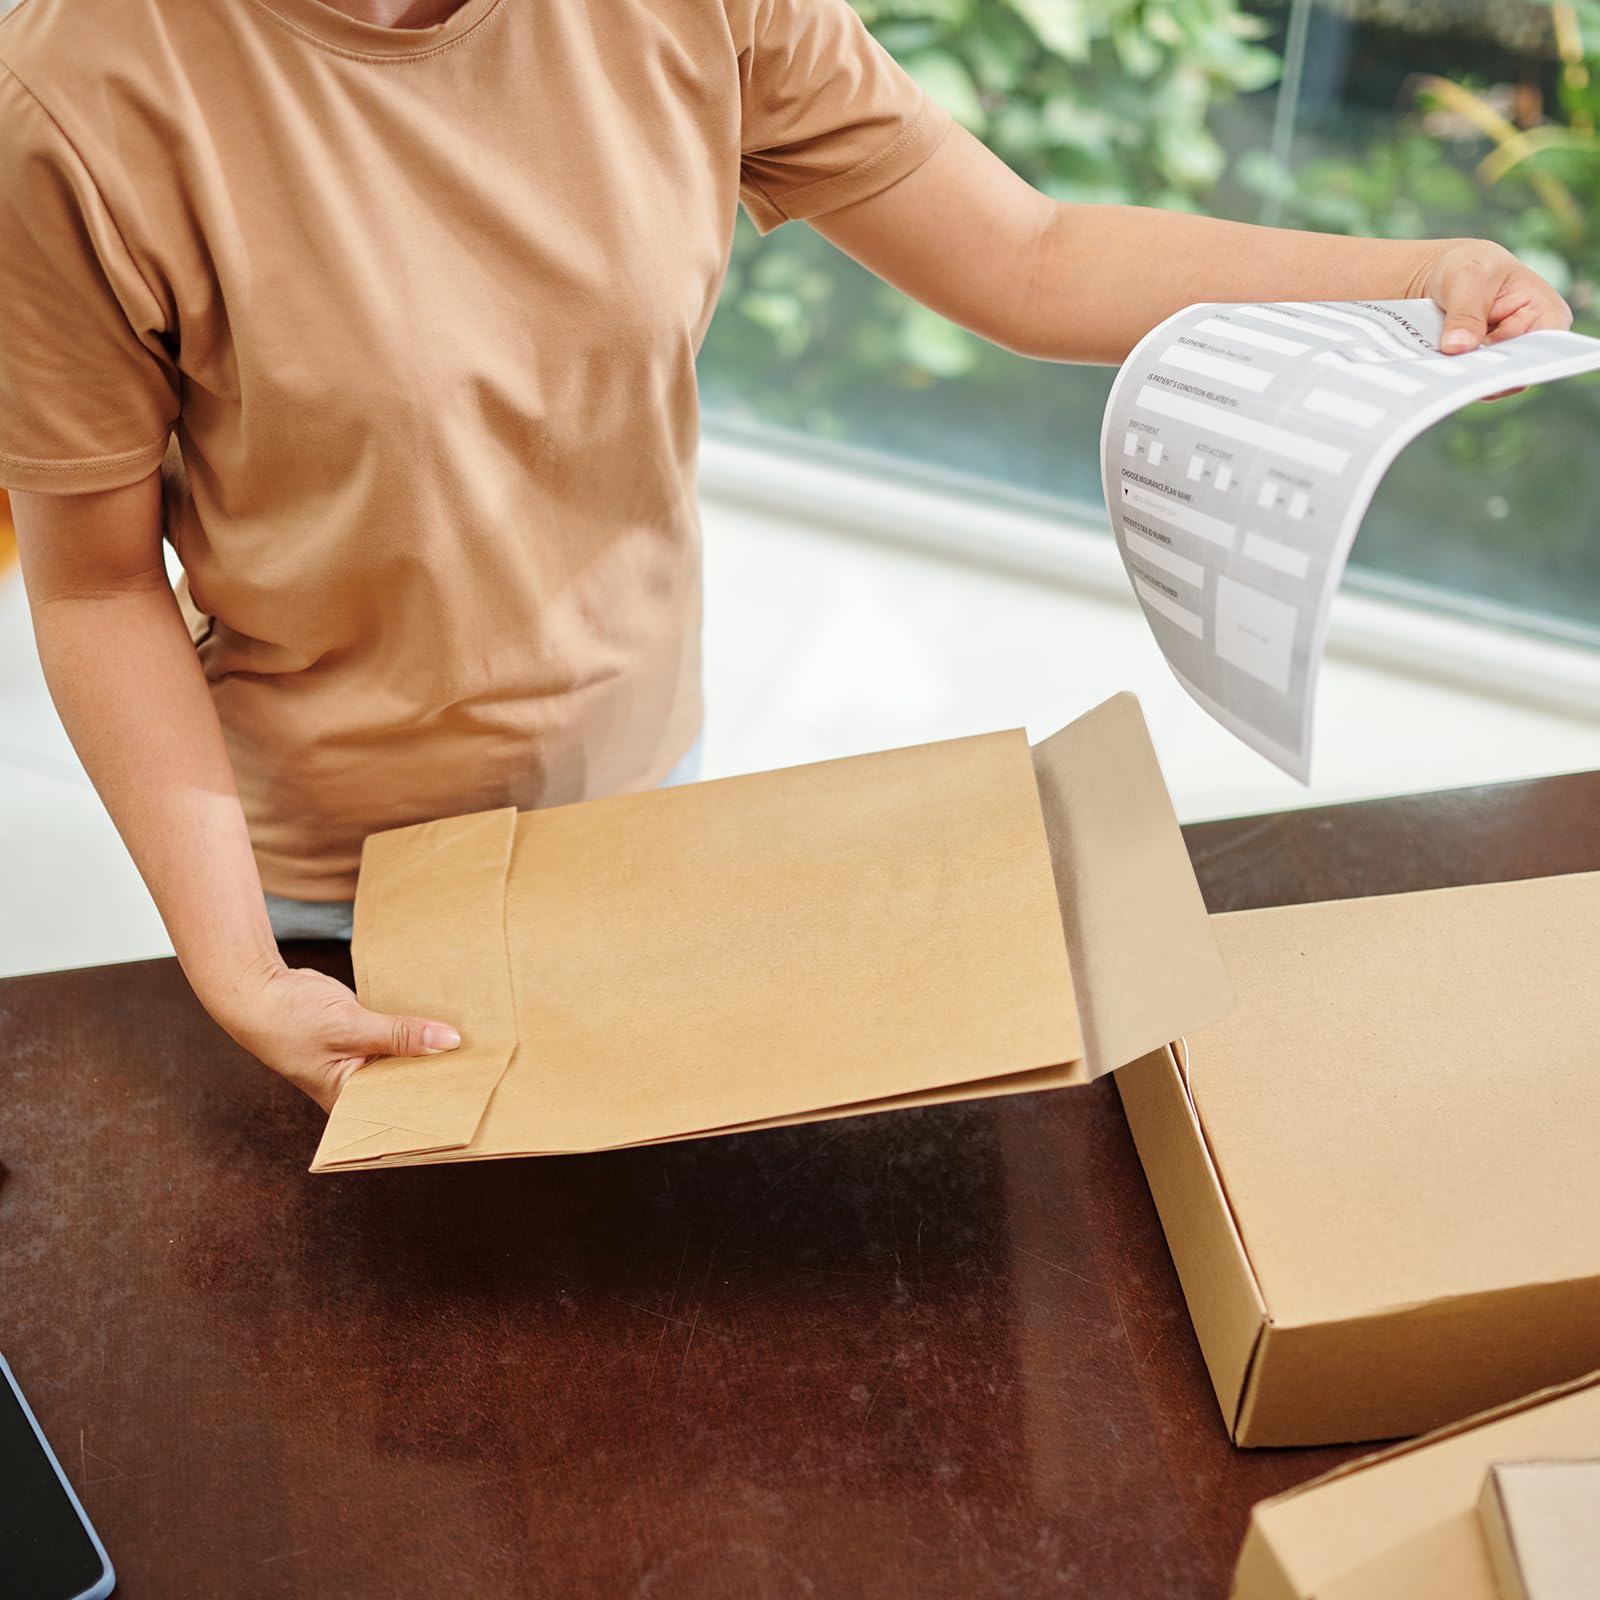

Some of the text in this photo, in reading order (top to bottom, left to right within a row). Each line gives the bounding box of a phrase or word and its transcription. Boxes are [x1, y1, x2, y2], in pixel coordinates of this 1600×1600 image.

[1178, 336, 1208, 350] TELEPHONE
[1147, 373, 1154, 381] IS
[1153, 374, 1177, 388] PATIENT'S
[1177, 383, 1206, 397] CONDITION
[1205, 391, 1229, 405] RELATED
[1128, 419, 1159, 436] EMPLOYMENT
[1121, 468, 1139, 481] CHOOSE
[1139, 474, 1164, 491] INSURANCE
[1163, 485, 1177, 496] PLAN
